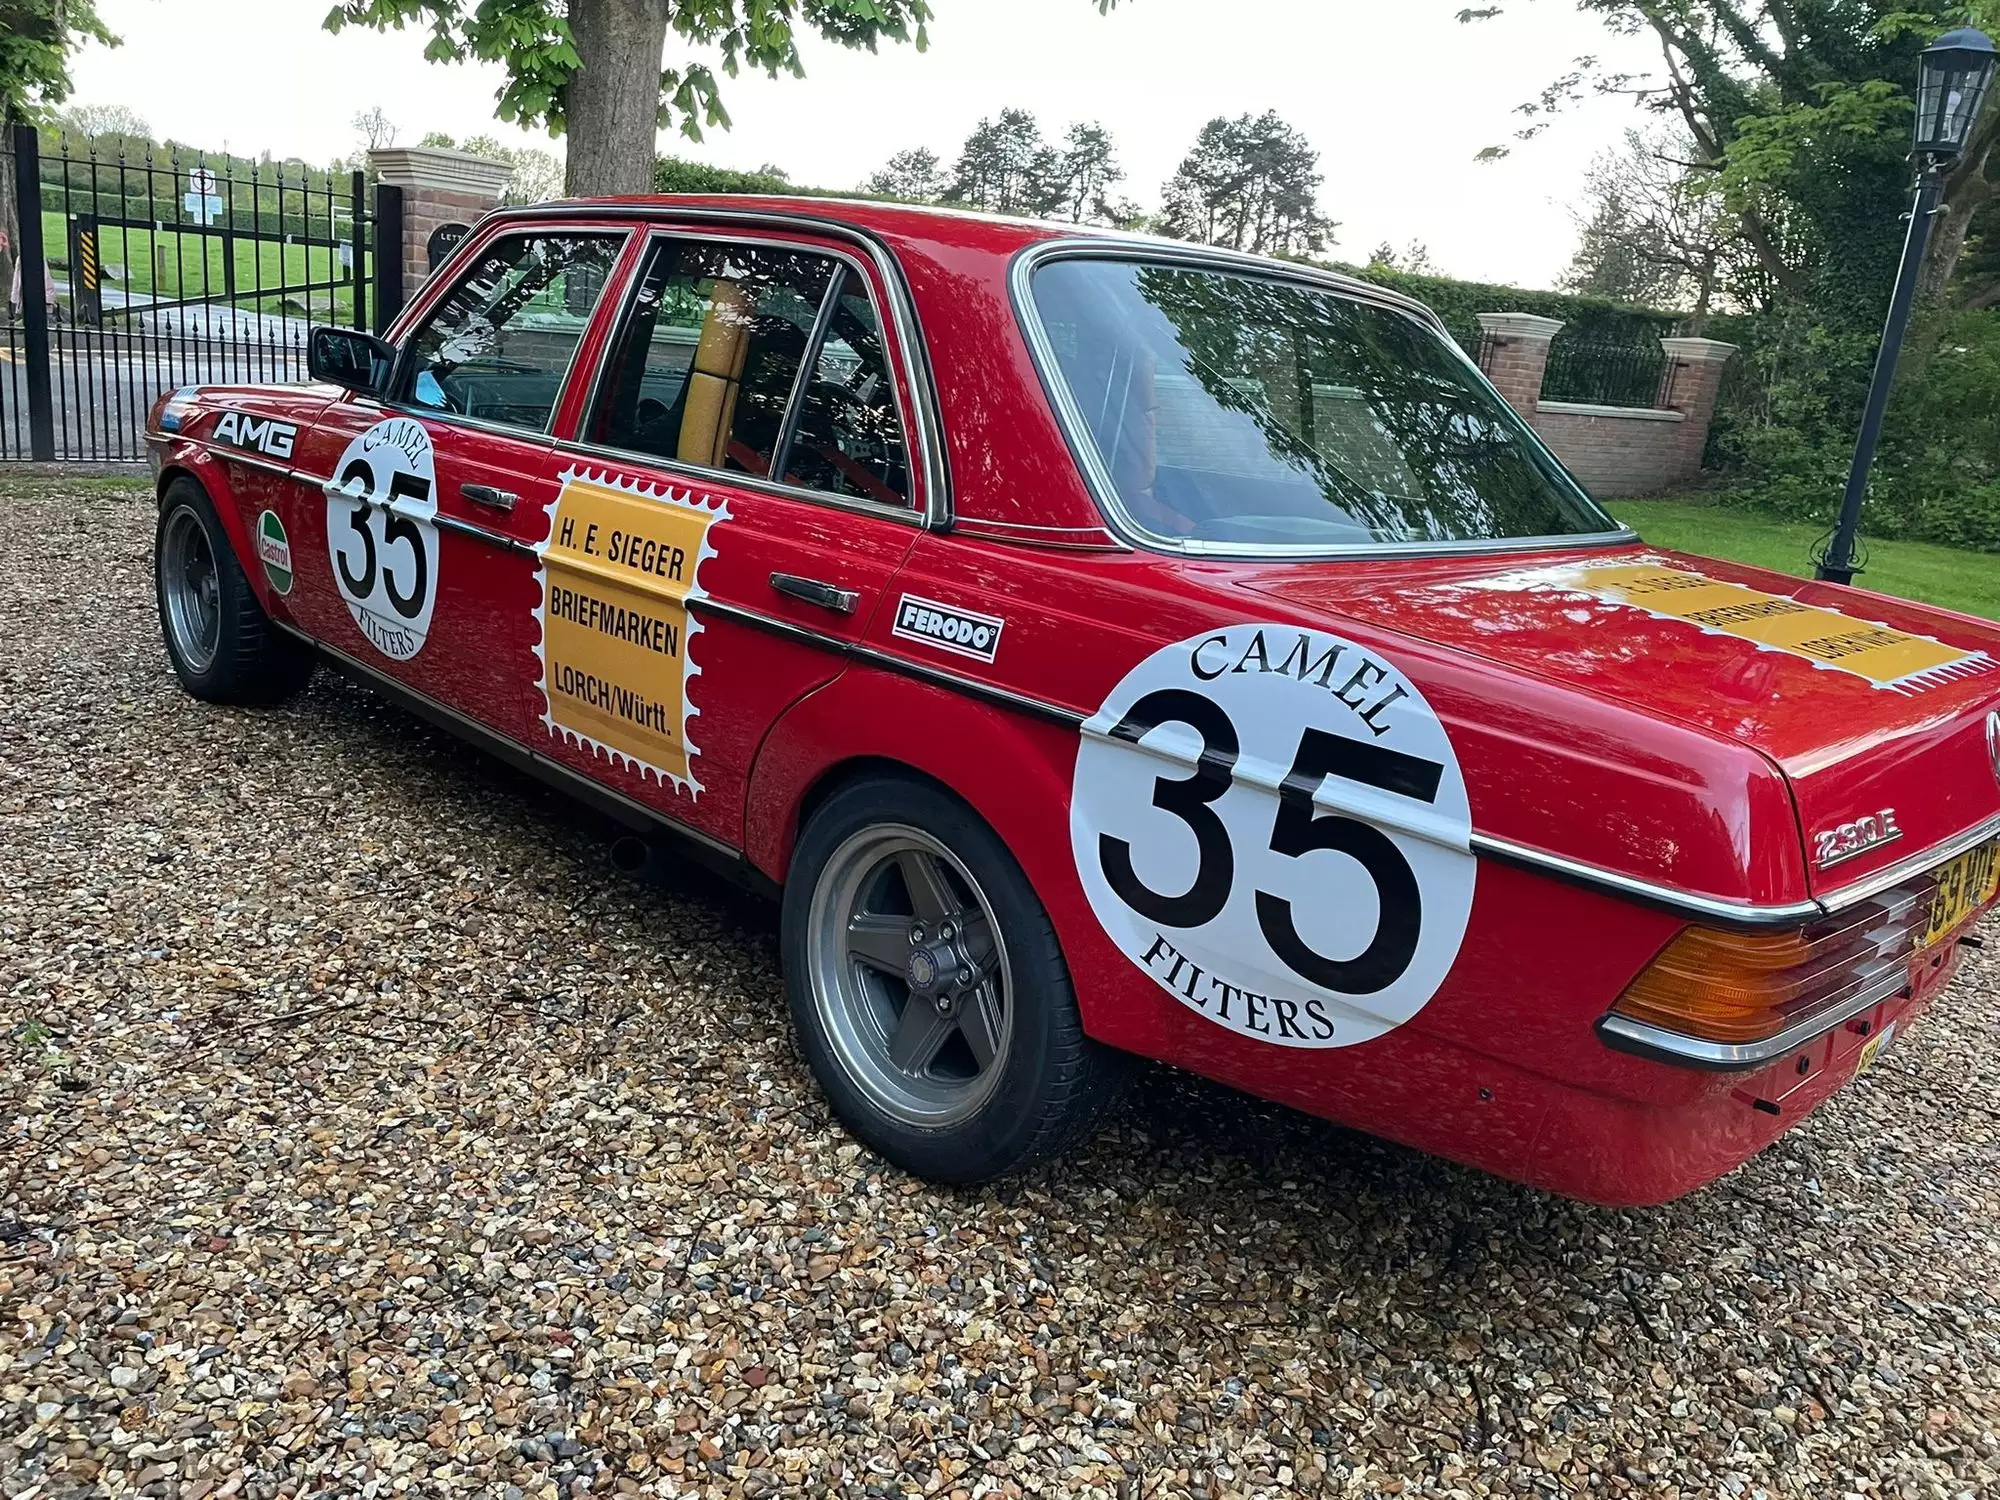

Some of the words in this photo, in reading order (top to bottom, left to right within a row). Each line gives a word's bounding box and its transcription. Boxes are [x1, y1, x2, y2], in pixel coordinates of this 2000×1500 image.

[212, 411, 298, 459] AMG
[363, 420, 429, 470] CAMEL
[261, 537, 288, 567] Castrol
[336, 458, 431, 619] 35
[559, 516, 577, 550] H.
[584, 523, 600, 557] E.
[608, 530, 685, 581] SIEGER
[358, 607, 415, 656] FILTERS
[551, 585, 678, 658] BRIEFMARKEN
[554, 661, 672, 736] LORCH/Württ.
[1190, 629, 1409, 737] CAMEL
[1098, 688, 1445, 995] 35
[1139, 932, 1335, 1040] FILTERS
